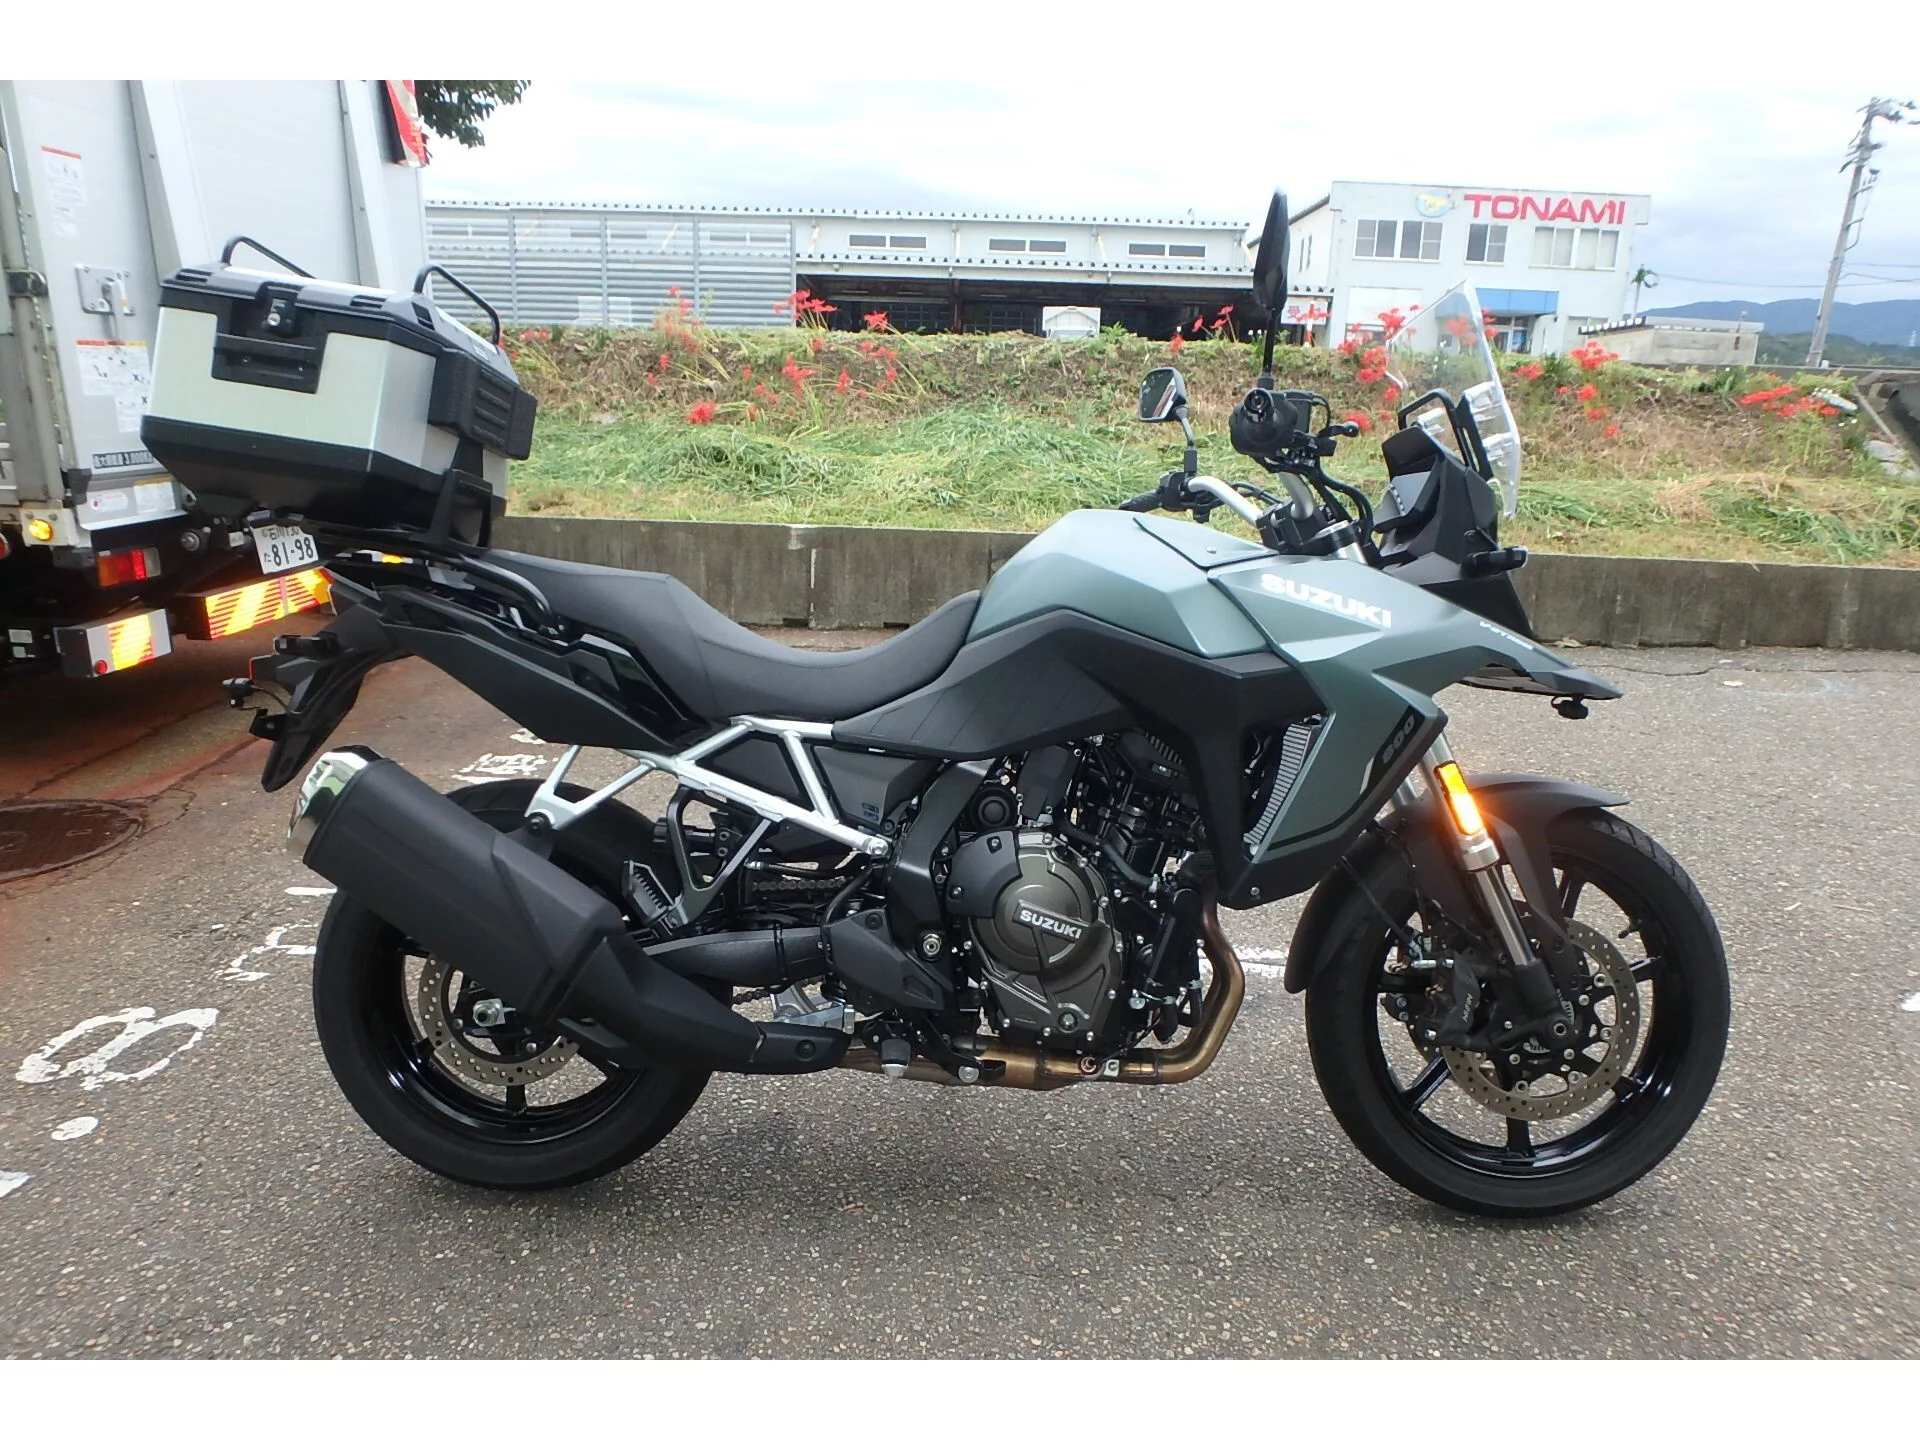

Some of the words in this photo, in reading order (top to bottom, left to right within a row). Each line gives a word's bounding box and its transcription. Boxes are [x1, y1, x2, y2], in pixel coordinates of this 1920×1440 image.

[1464, 194, 1626, 225] TONAMI
[272, 536, 314, 566] 81-98
[1260, 573, 1392, 628] SUZUKI
[1382, 713, 1415, 764] 800
[1020, 909, 1082, 939] SUZUKI
